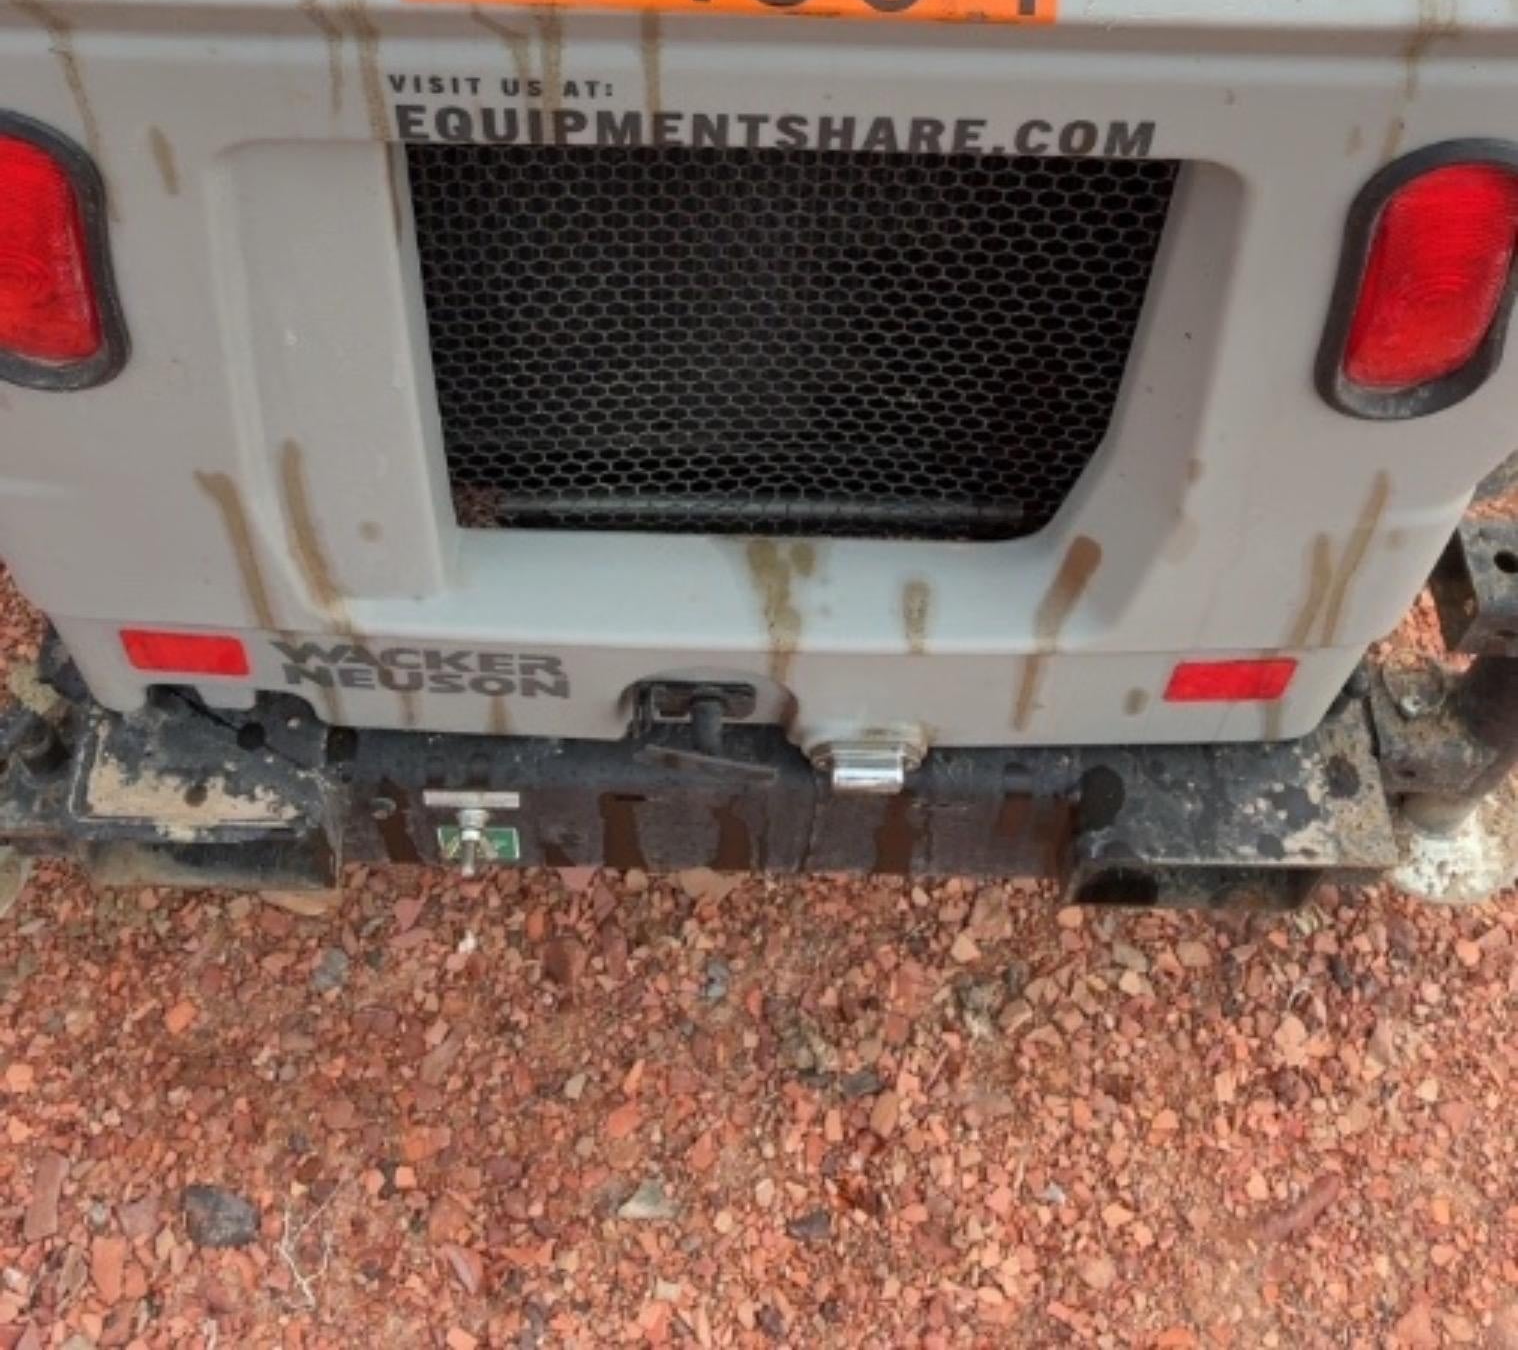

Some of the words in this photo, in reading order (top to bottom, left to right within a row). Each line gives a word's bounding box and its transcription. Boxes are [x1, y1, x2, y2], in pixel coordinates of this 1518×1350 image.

[388, 74, 481, 95] VISIT
[501, 78, 543, 97] US
[562, 80, 614, 98] AT:
[395, 104, 1156, 157] EQUIPMENTSHARE.COM
[270, 642, 563, 677] WACKER
[282, 663, 571, 699] NEUSON
